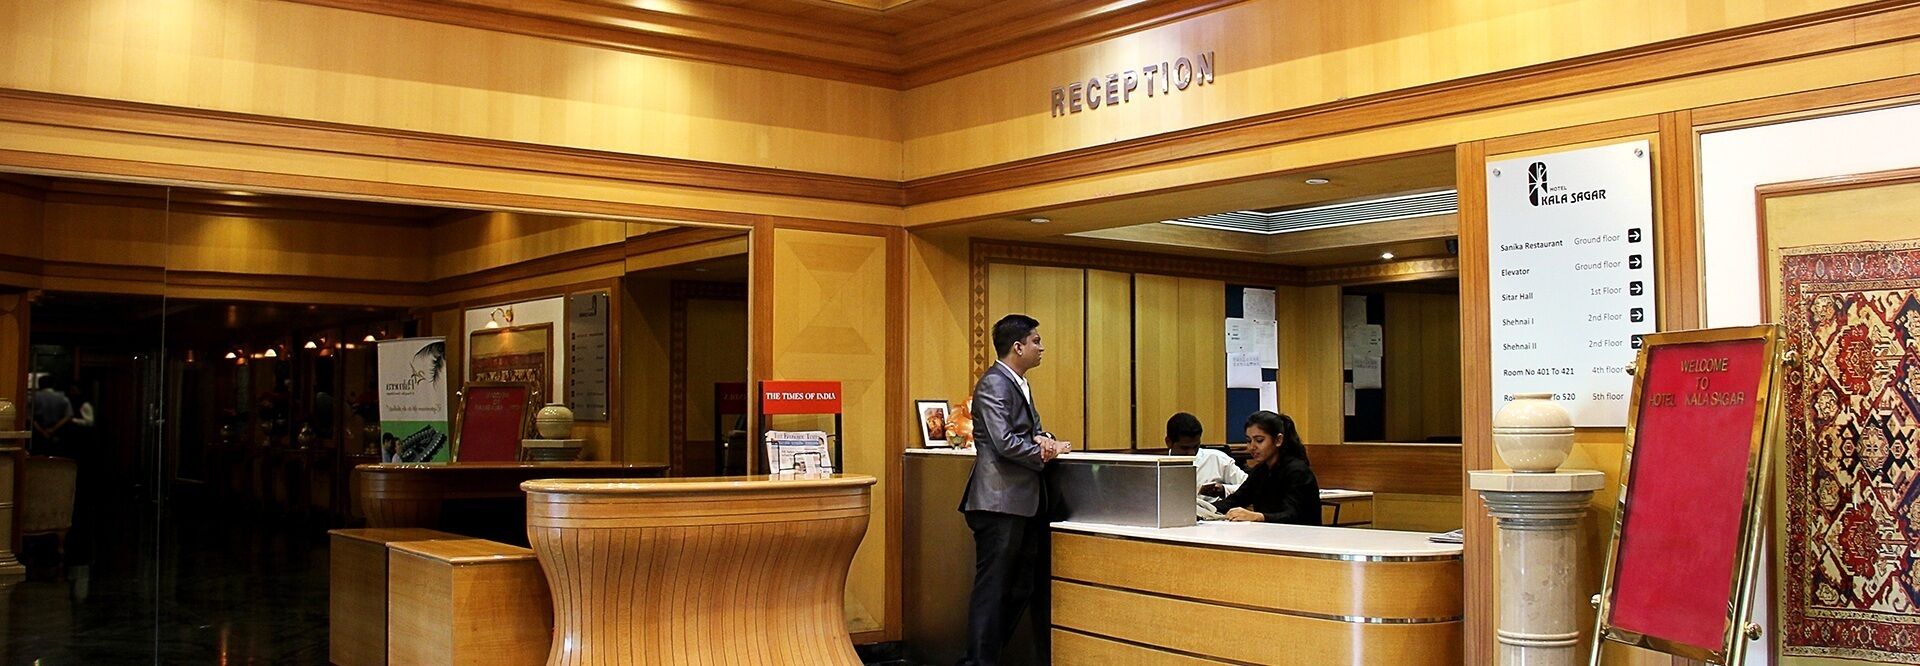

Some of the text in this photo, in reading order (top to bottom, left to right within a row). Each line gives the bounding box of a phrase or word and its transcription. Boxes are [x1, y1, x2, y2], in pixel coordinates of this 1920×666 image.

[1051, 51, 1215, 117] RECEPTION
[1541, 189, 1607, 206] KALA SAGAR
[1500, 234, 1620, 251] Sanika Restaurant Ground floor
[1501, 260, 1621, 277] Elevator Ground floor
[1501, 287, 1622, 301] Sitar Hall 1st Floor
[1502, 318, 1530, 326] Shehnai
[1588, 313, 1602, 322] 2nd
[1603, 313, 1622, 321] Floor
[1589, 340, 1602, 348] 2nd
[1604, 339, 1623, 347] Floor
[1525, 368, 1535, 376] No
[1537, 368, 1550, 376] 401
[1561, 367, 1574, 375] 421
[1592, 366, 1604, 374] 4th
[1606, 365, 1623, 374] floor
[1681, 357, 1729, 373] WELCOME
[1695, 376, 1709, 391] TO
[766, 392, 836, 400] THE TIMES OF INDIA
[1562, 393, 1576, 401] 520
[1592, 392, 1605, 400] 5th
[1606, 392, 1624, 400] floor
[1649, 393, 1676, 408] HOTEL
